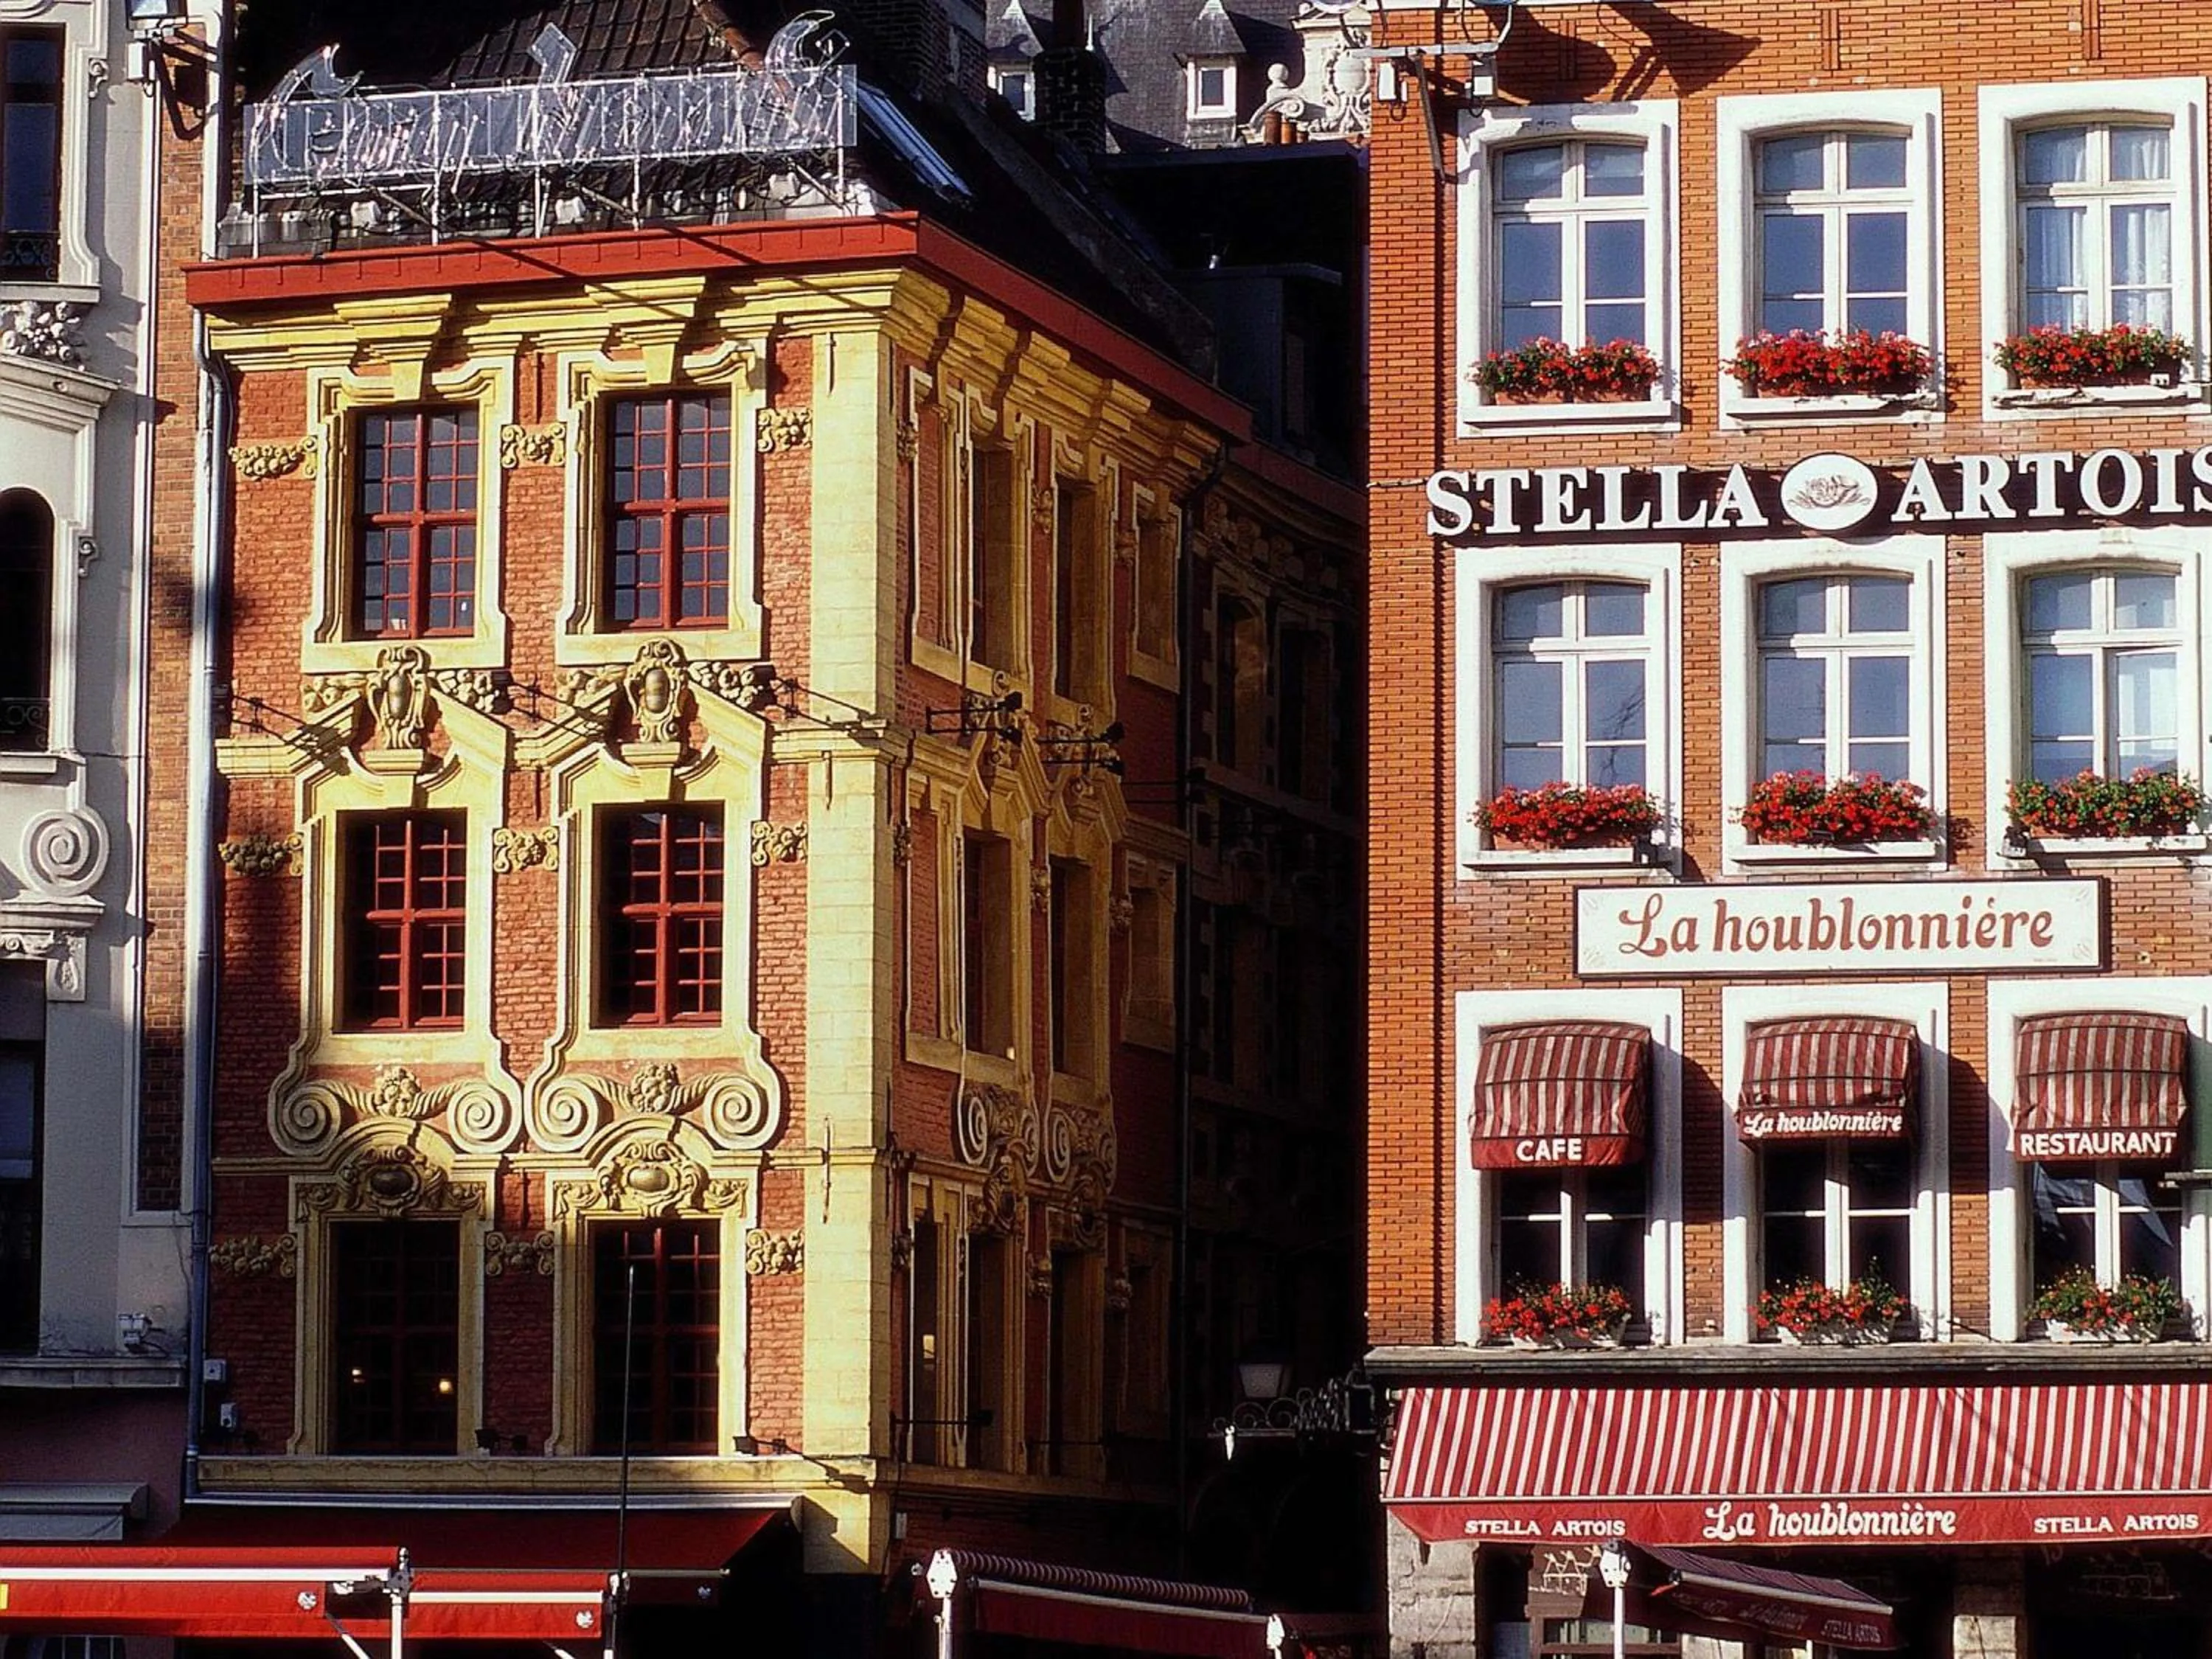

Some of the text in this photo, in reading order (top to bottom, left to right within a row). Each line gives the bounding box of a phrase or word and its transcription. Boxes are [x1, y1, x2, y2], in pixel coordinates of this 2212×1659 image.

[1426, 462, 1769, 536] STELLA
[1618, 893, 1700, 958] La
[1744, 1112, 1773, 1138] La
[1516, 1138, 1582, 1162] CAFE
[2020, 1131, 2177, 1156] RESTAURANT
[1464, 1520, 1626, 1536] STELLA ARTOIS
[1703, 1501, 1956, 1541] La houblonnière
[2034, 1514, 2199, 1534] STELLA ARTOIS
